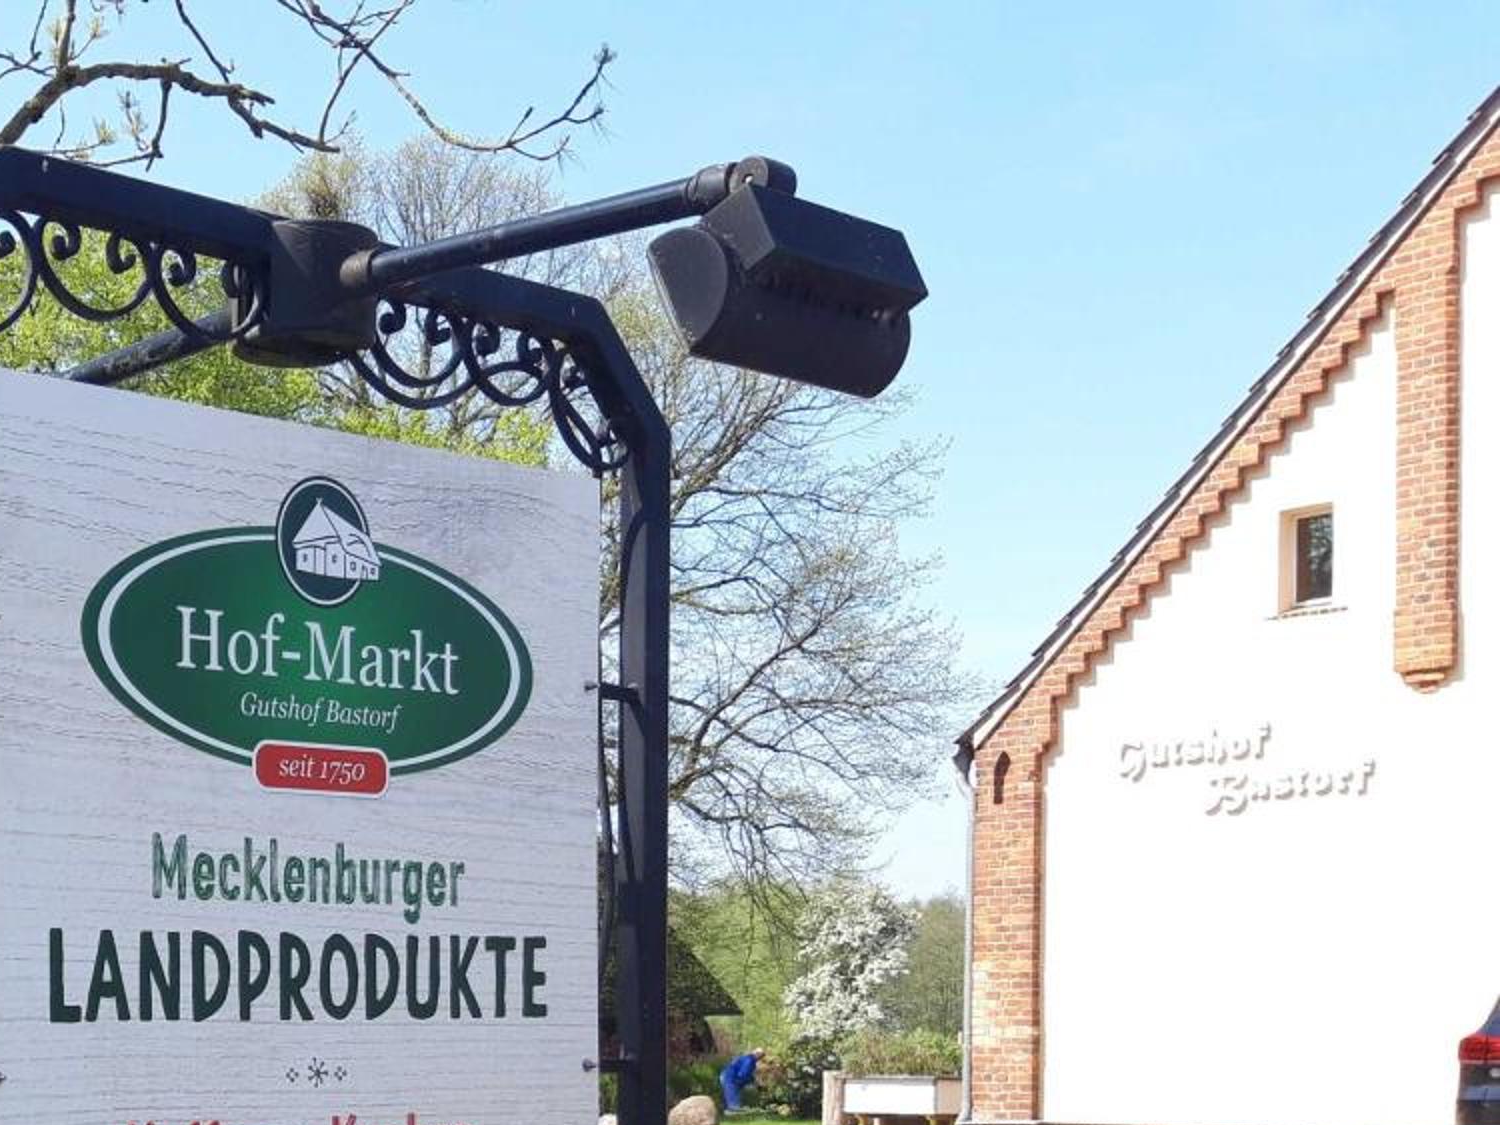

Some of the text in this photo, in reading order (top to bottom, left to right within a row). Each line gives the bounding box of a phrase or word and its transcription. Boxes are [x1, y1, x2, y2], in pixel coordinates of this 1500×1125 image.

[176, 605, 460, 695] Hof-Markt
[240, 691, 402, 734] Gutshof Bastorf
[279, 754, 367, 786] seit 1750
[152, 832, 465, 924] Mecklenburger
[49, 927, 548, 1023] LANDPRODUKTE
